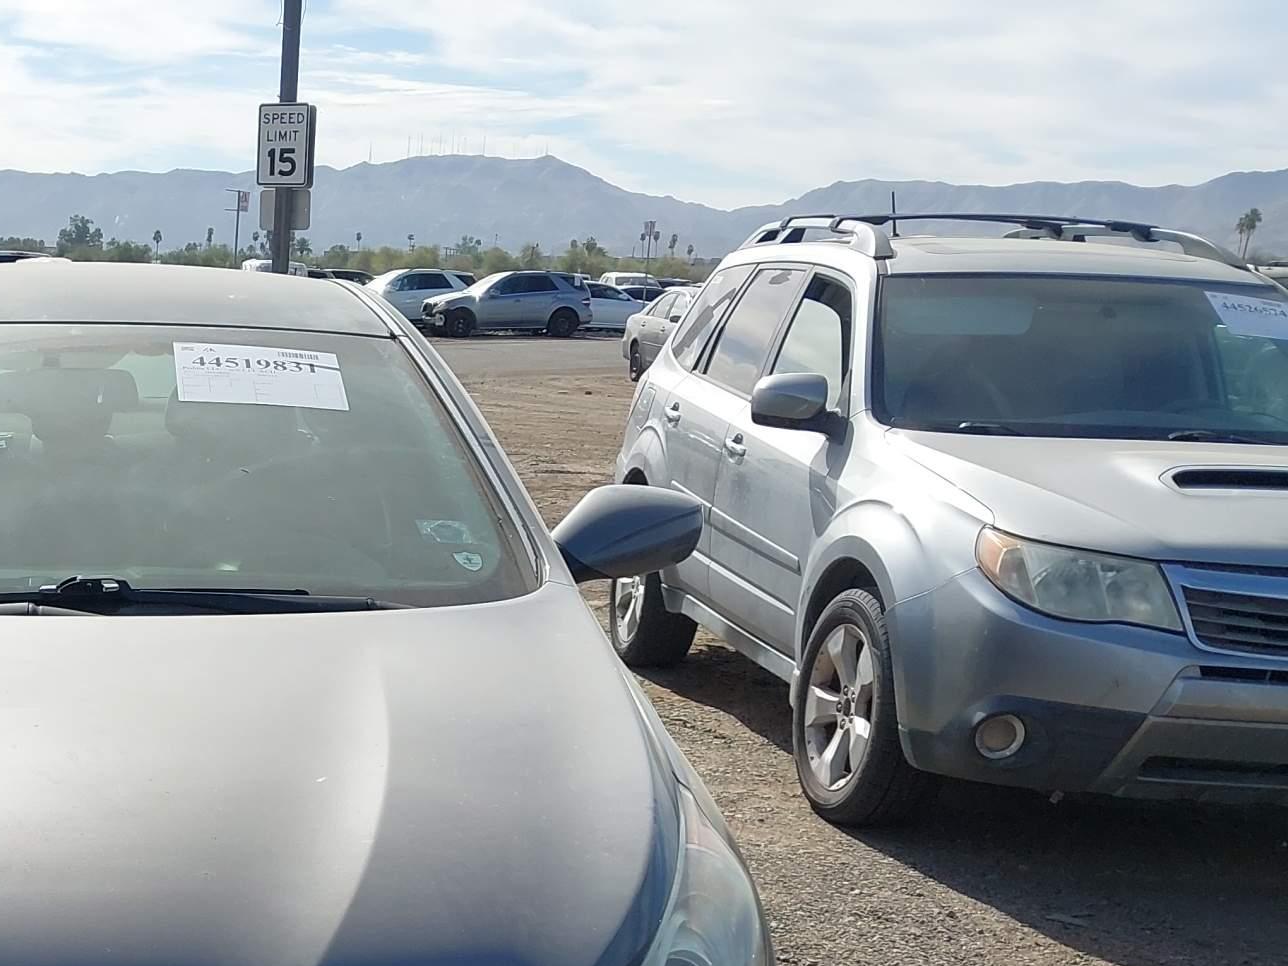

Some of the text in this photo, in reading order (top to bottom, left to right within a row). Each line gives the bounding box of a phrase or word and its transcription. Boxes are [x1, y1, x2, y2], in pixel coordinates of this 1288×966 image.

[262, 112, 305, 125] SPEED
[266, 130, 300, 142] LIMIT
[267, 147, 297, 177] 15
[192, 355, 317, 374] 44519831
